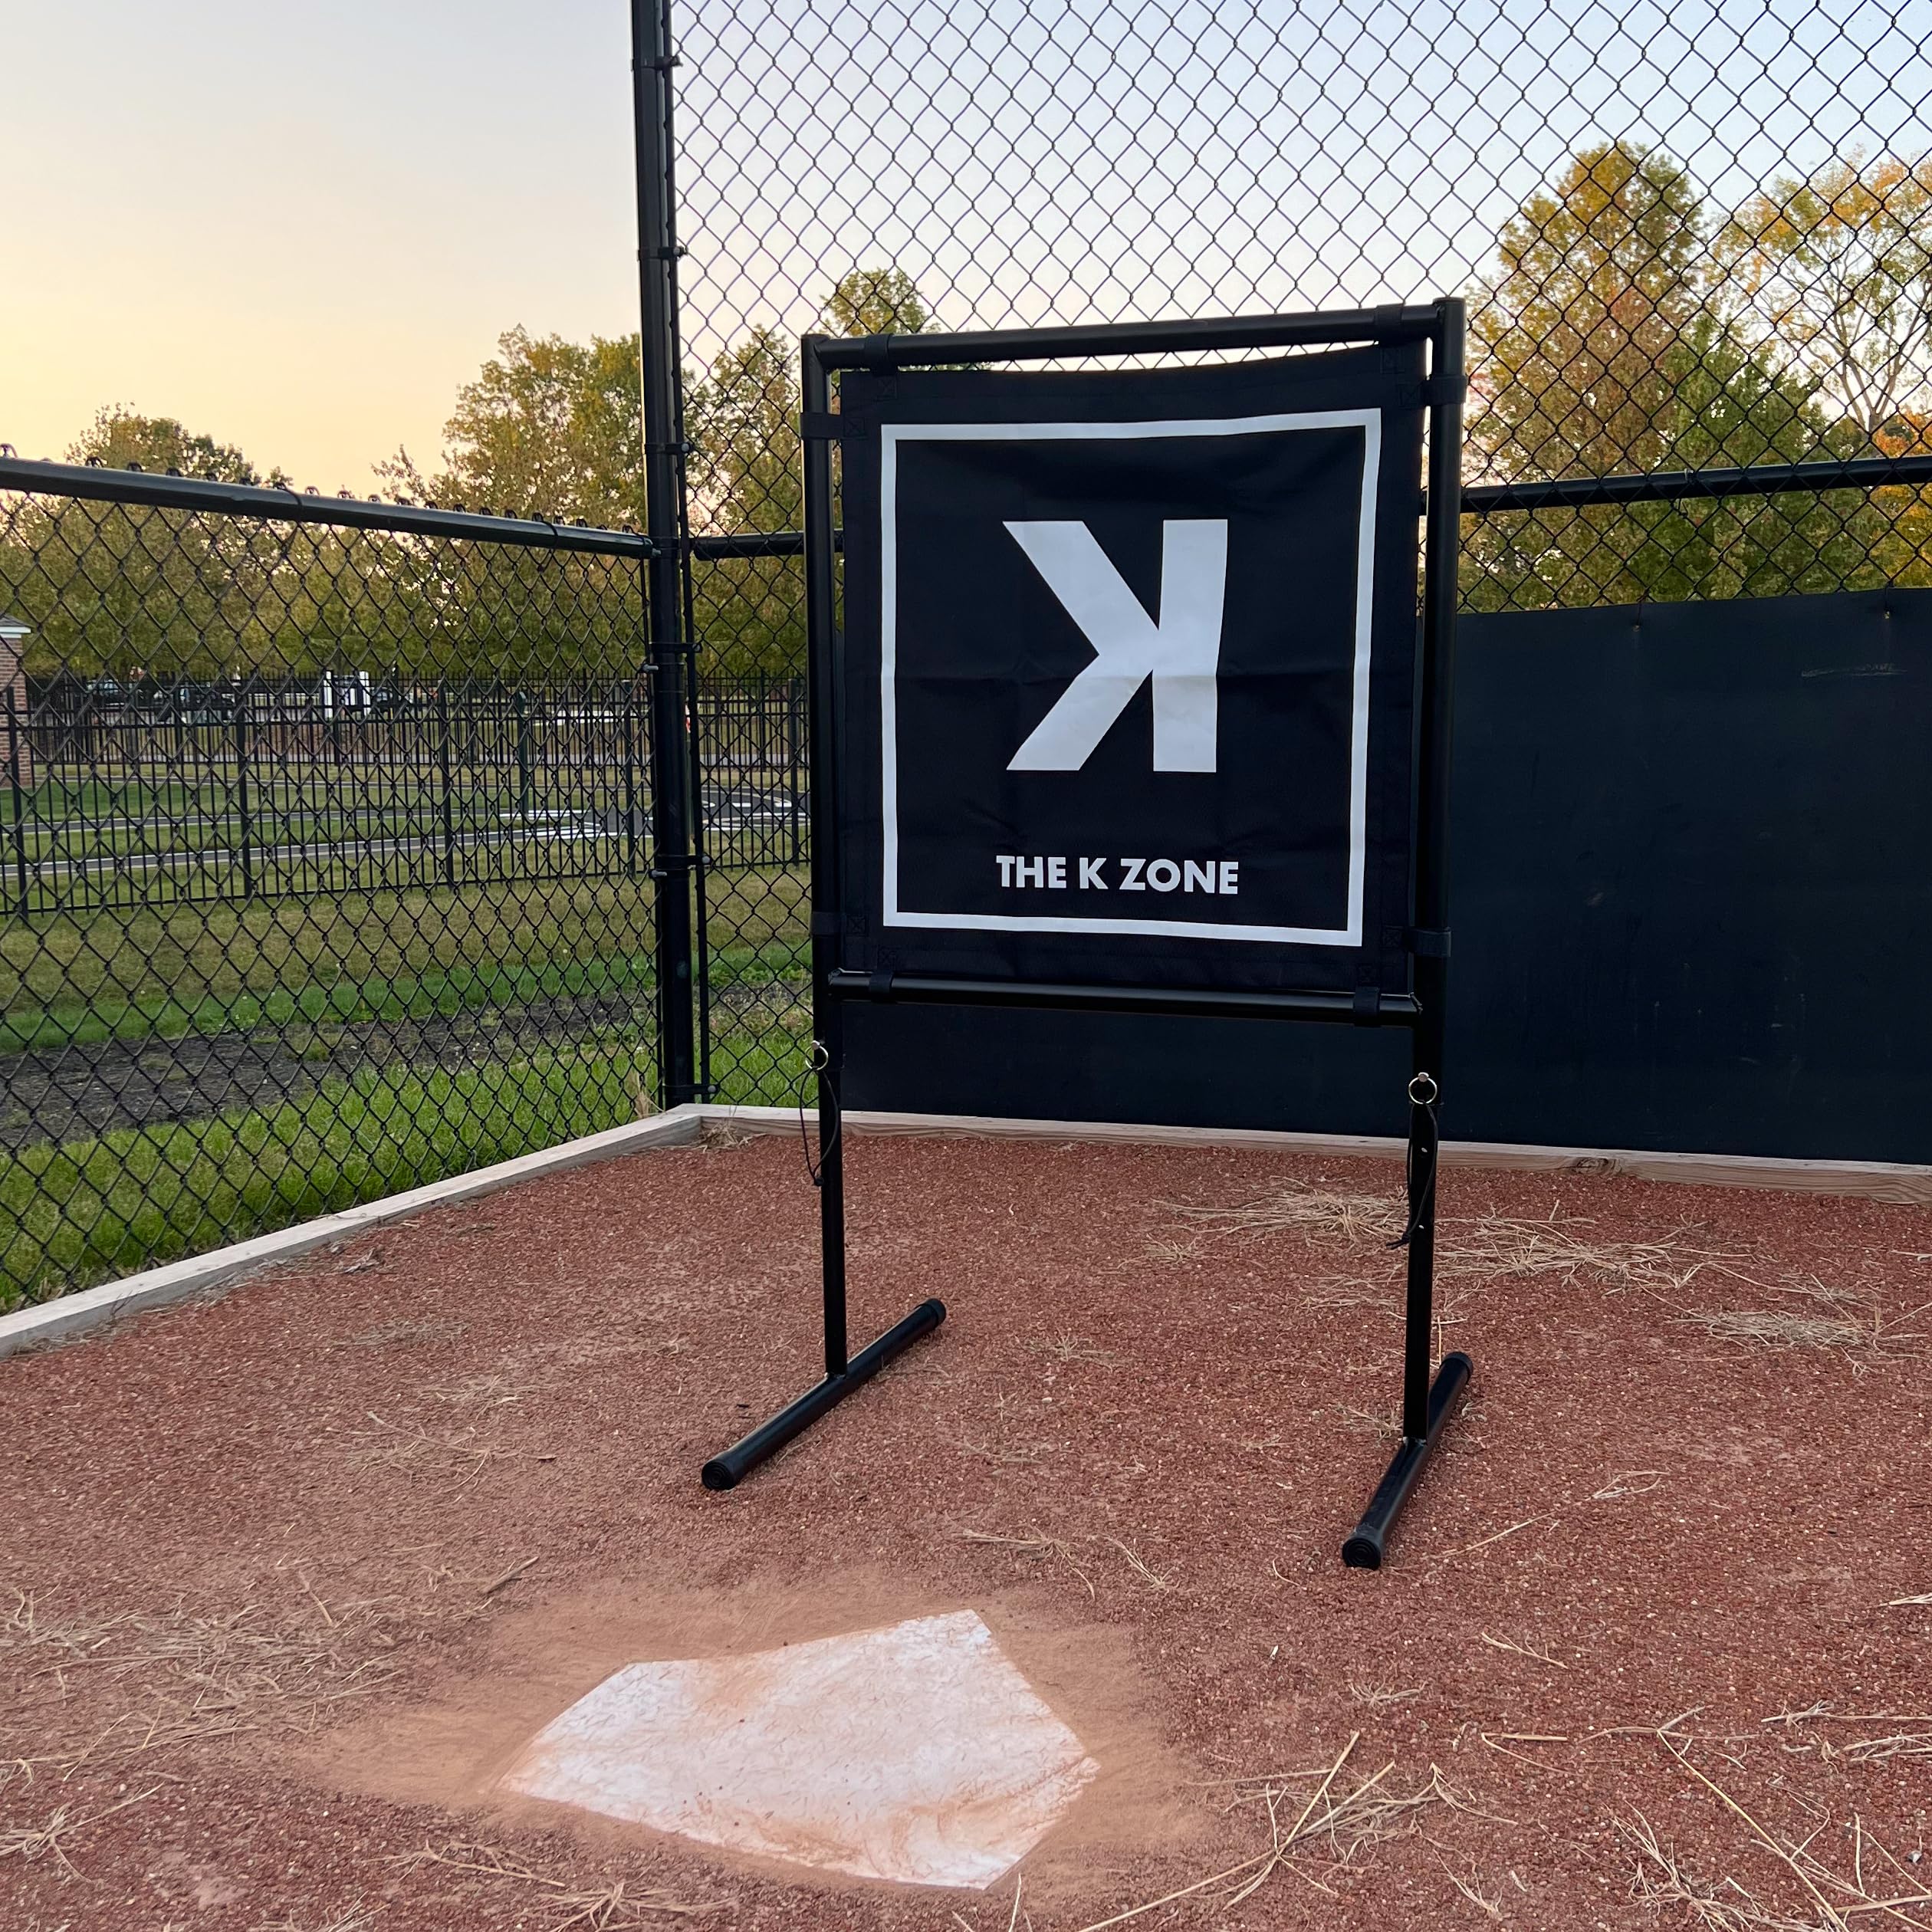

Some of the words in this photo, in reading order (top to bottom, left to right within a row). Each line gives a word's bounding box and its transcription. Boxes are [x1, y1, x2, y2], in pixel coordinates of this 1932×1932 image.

[996, 855, 1067, 889] THE
[1079, 857, 1109, 890] K
[1119, 858, 1239, 895] ZONE
